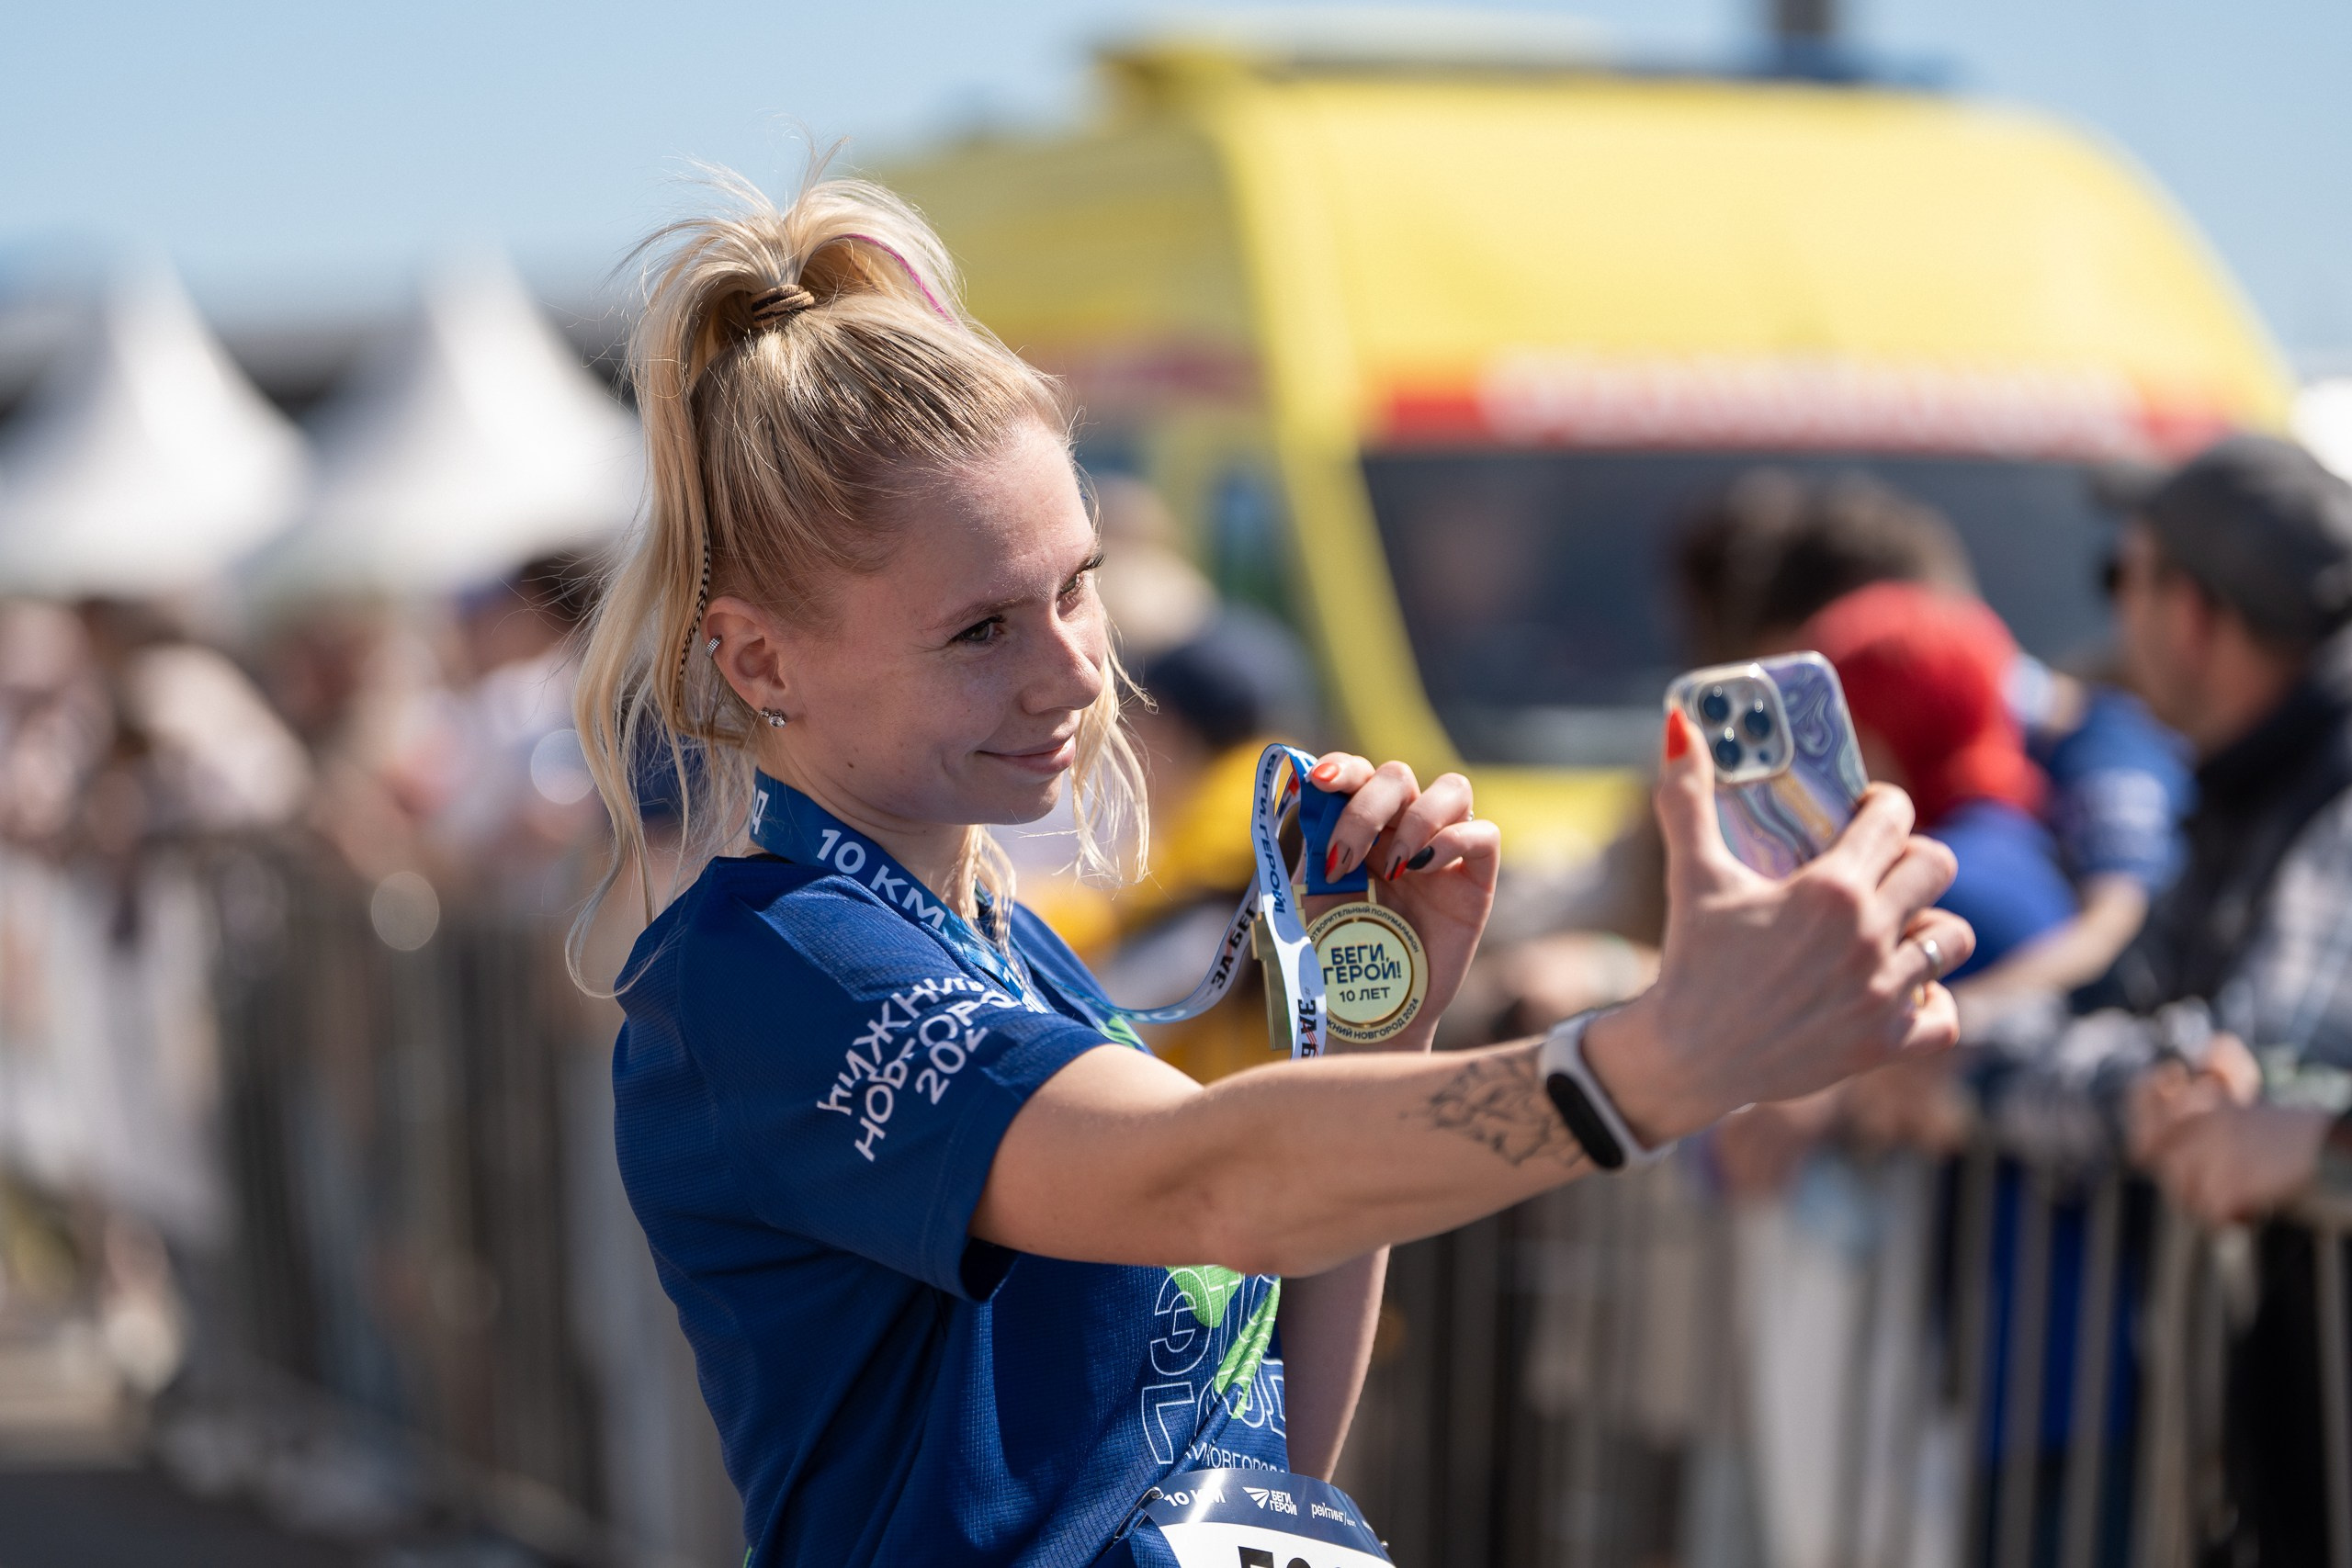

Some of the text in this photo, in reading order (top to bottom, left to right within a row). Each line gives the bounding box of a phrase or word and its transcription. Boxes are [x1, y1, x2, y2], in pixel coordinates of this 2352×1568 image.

[817, 829, 945, 929] 10 КМ
[1260, 823, 1286, 914] ГЕРОЙ!
[1309, 906, 1372, 942] ОТВОРИТЕЛЬНЫЙ
[1331, 942, 1390, 966] БЕГИ,
[1323, 961, 1402, 986] ГЕРОЙ!
[1340, 987, 1391, 1003] 10 ЛЕТ
[1327, 998, 1419, 1040] ЖНИЙ НОВГОРОД 2024
[1163, 1491, 1190, 1507] 10
